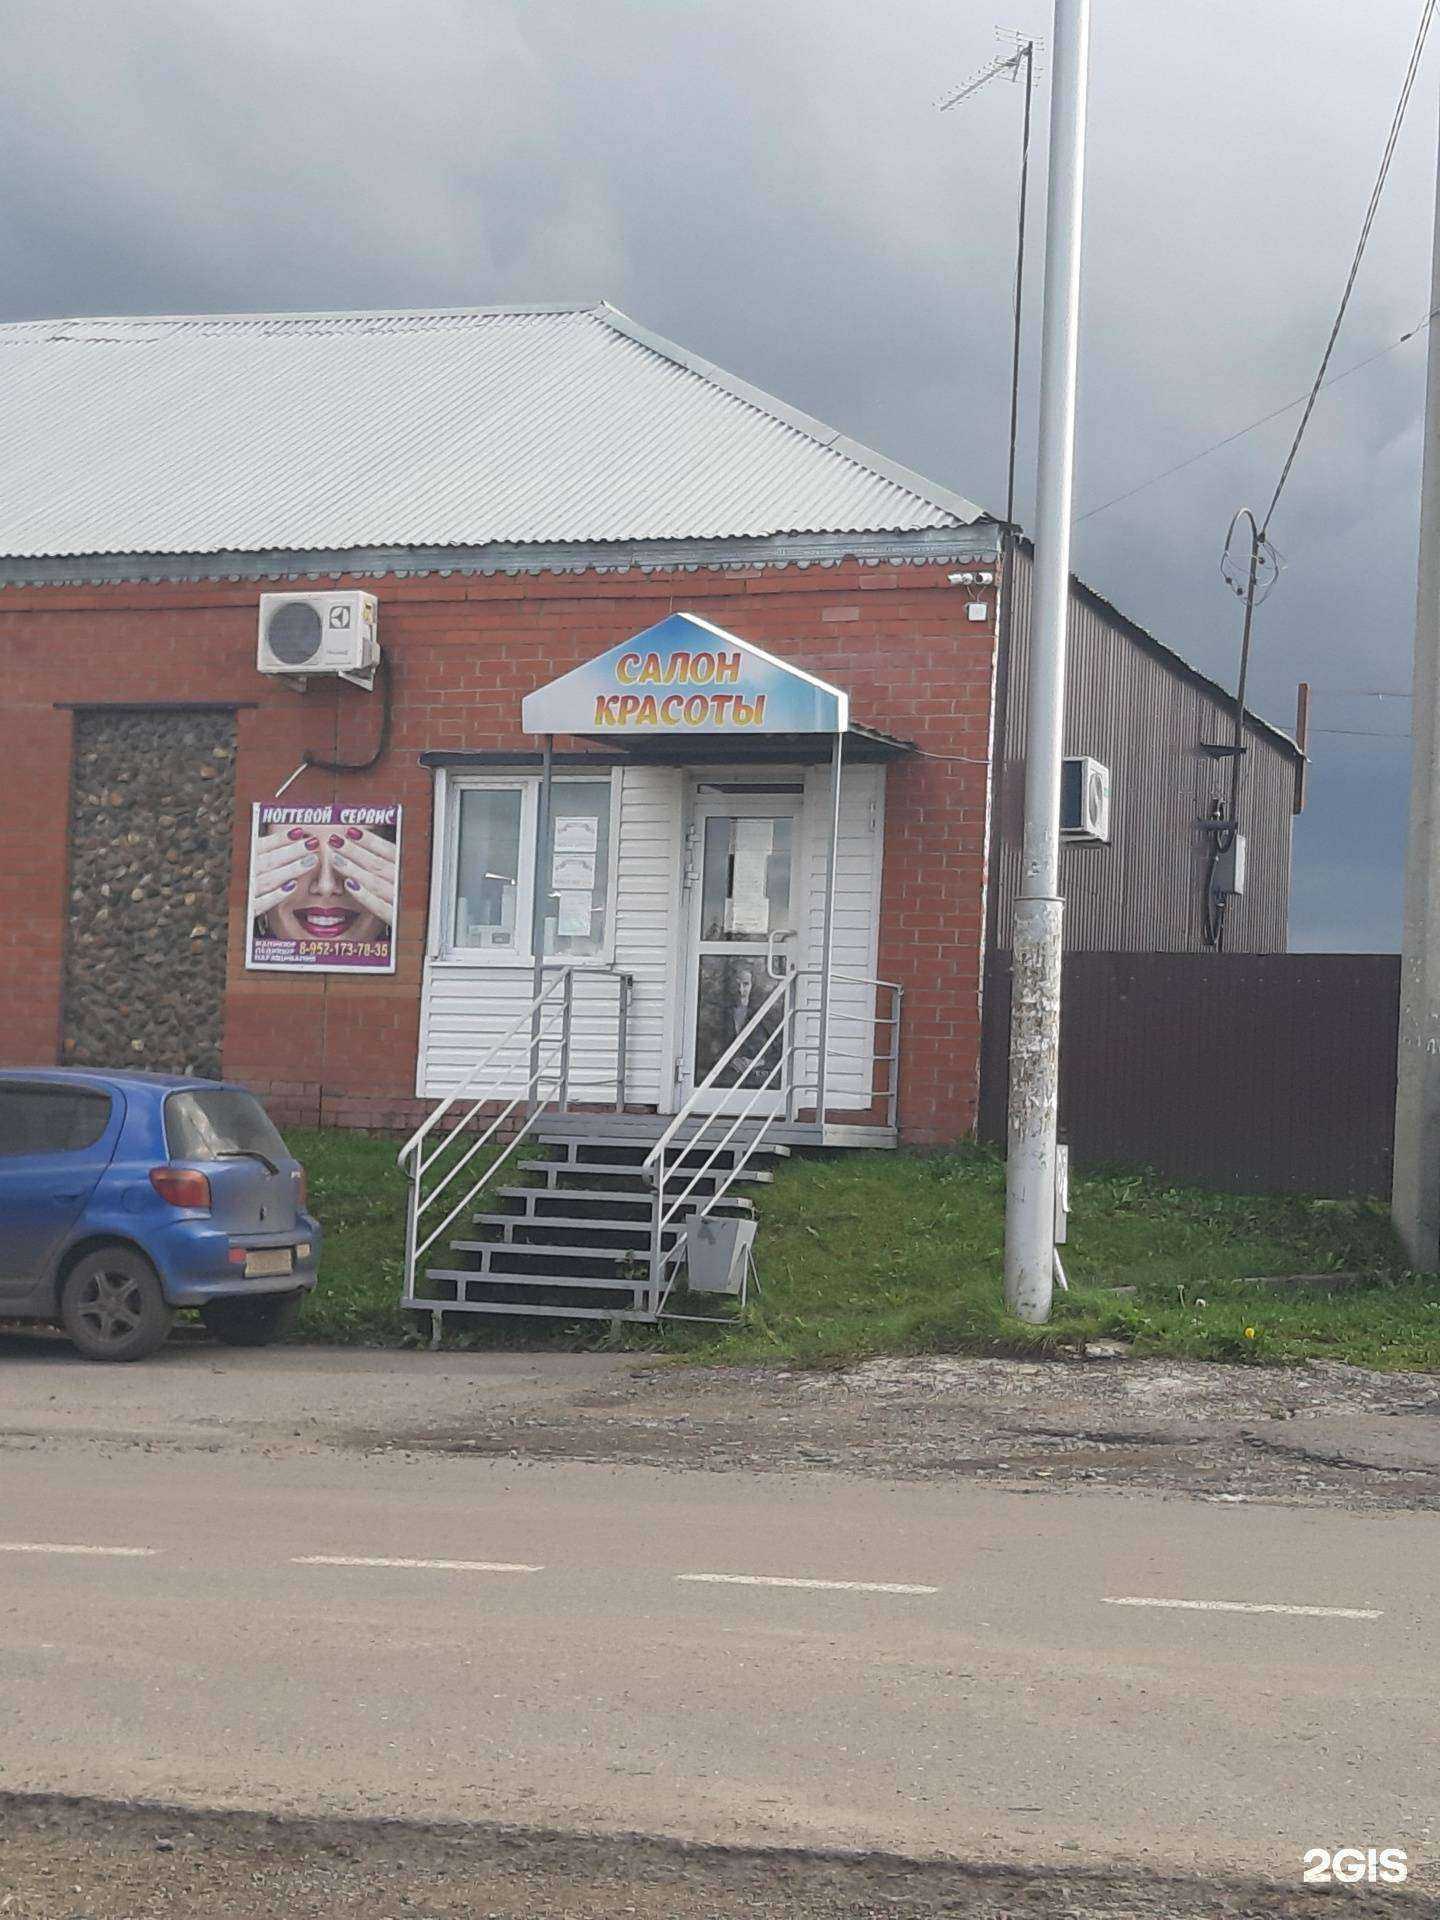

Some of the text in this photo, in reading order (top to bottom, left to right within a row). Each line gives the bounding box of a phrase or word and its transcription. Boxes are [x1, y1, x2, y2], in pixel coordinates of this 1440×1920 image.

[615, 652, 742, 684] САЛОН
[594, 694, 767, 726] КРАСОТЫ
[262, 805, 395, 824] НОГТЕВОЙ СЕРВИС
